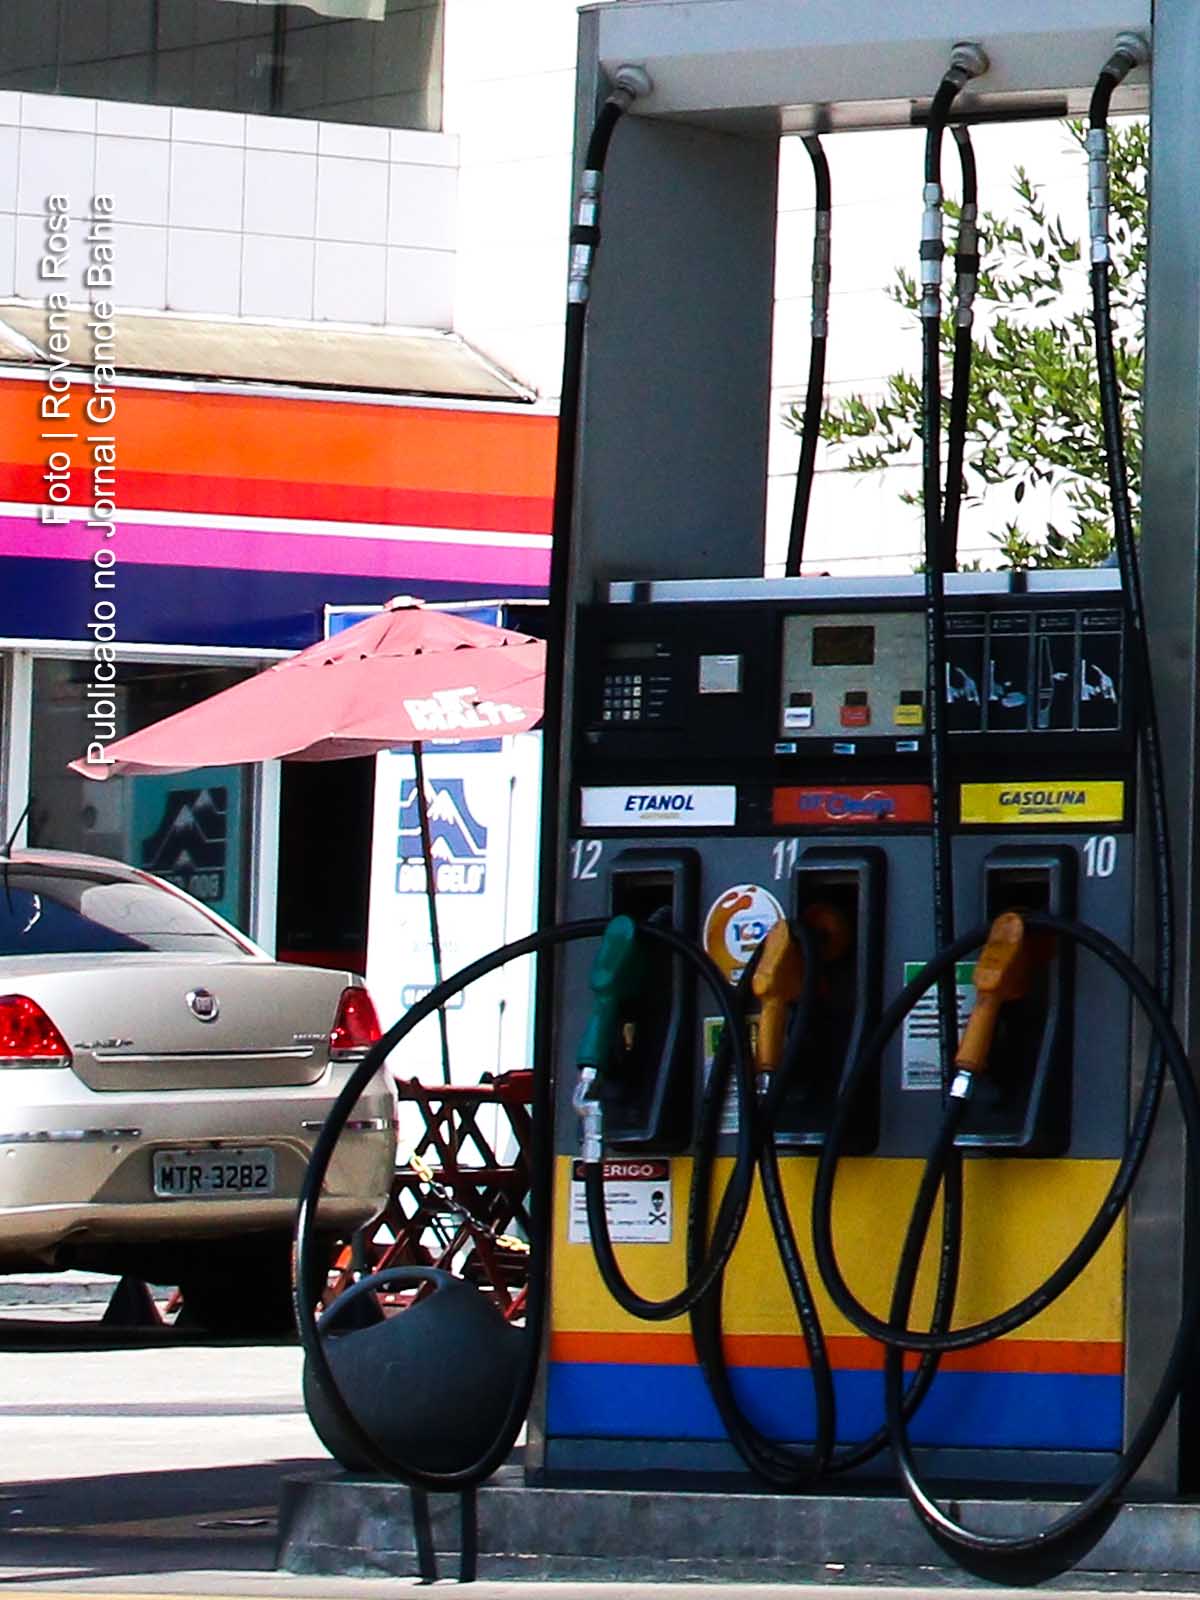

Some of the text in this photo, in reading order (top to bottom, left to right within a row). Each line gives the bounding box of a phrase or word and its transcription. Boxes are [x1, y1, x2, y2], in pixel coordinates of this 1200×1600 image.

[624, 794, 695, 811] ETANOL
[999, 790, 1087, 806] GASOLINA
[571, 839, 603, 880] 12
[772, 838, 800, 880] 11
[1083, 835, 1117, 878] 10
[602, 1163, 654, 1177] ERIGO
